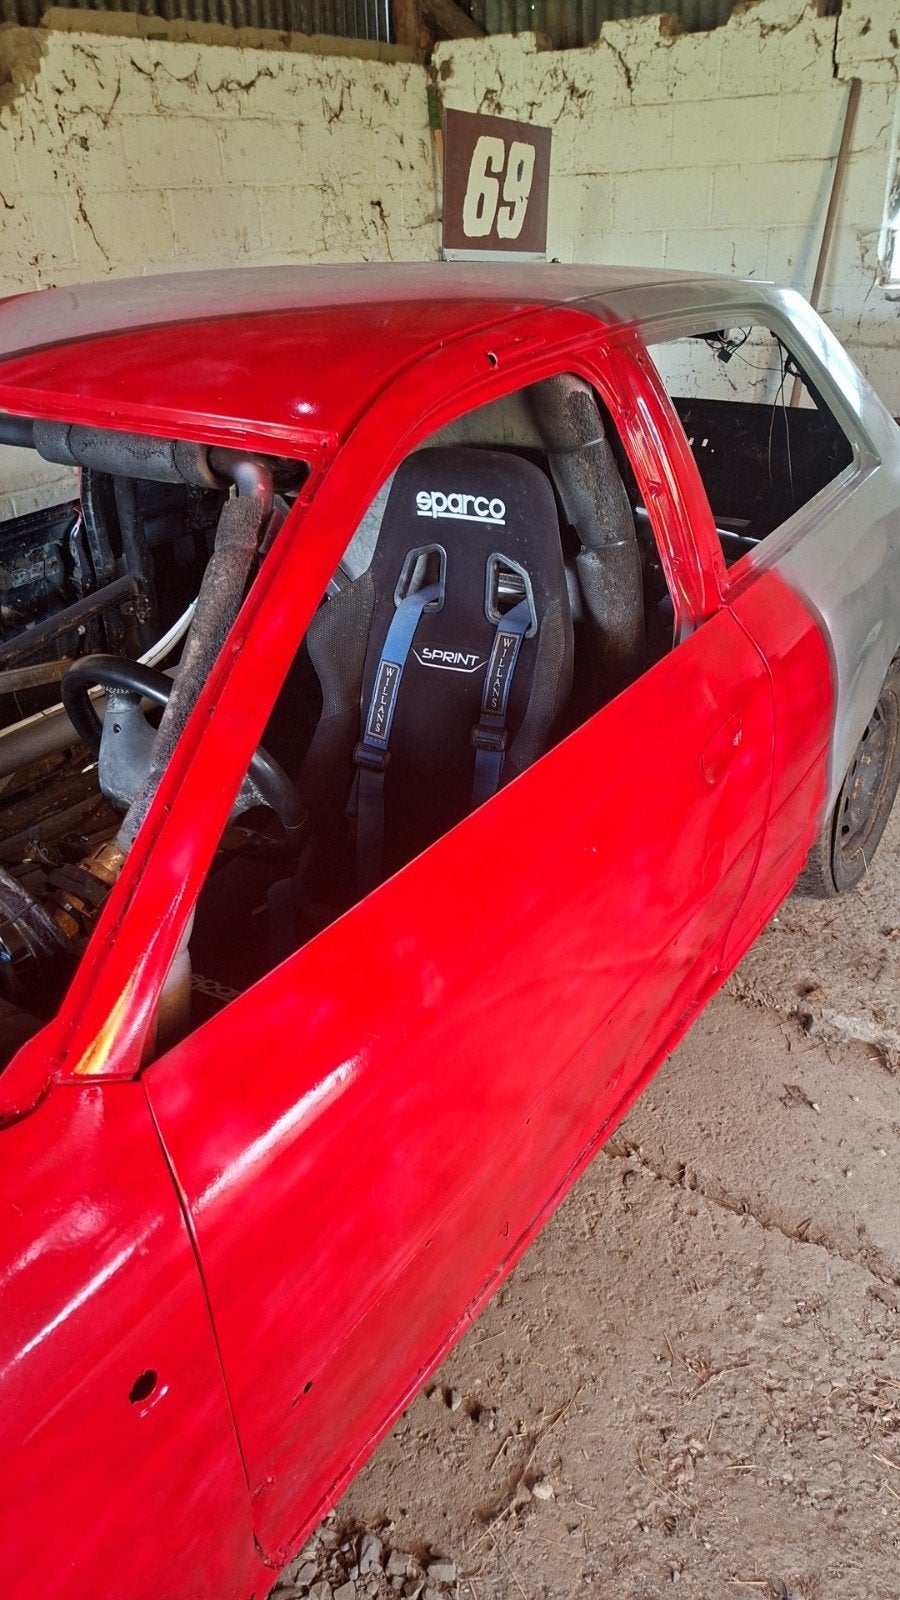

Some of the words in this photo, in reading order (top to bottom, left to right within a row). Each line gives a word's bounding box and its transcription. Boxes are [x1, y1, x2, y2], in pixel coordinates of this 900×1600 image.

[462, 135, 536, 239] 69
[416, 491, 506, 520] sparco
[421, 648, 480, 666] SPRINT
[491, 637, 513, 708] WILLANS
[374, 667, 396, 733] WILLANS
